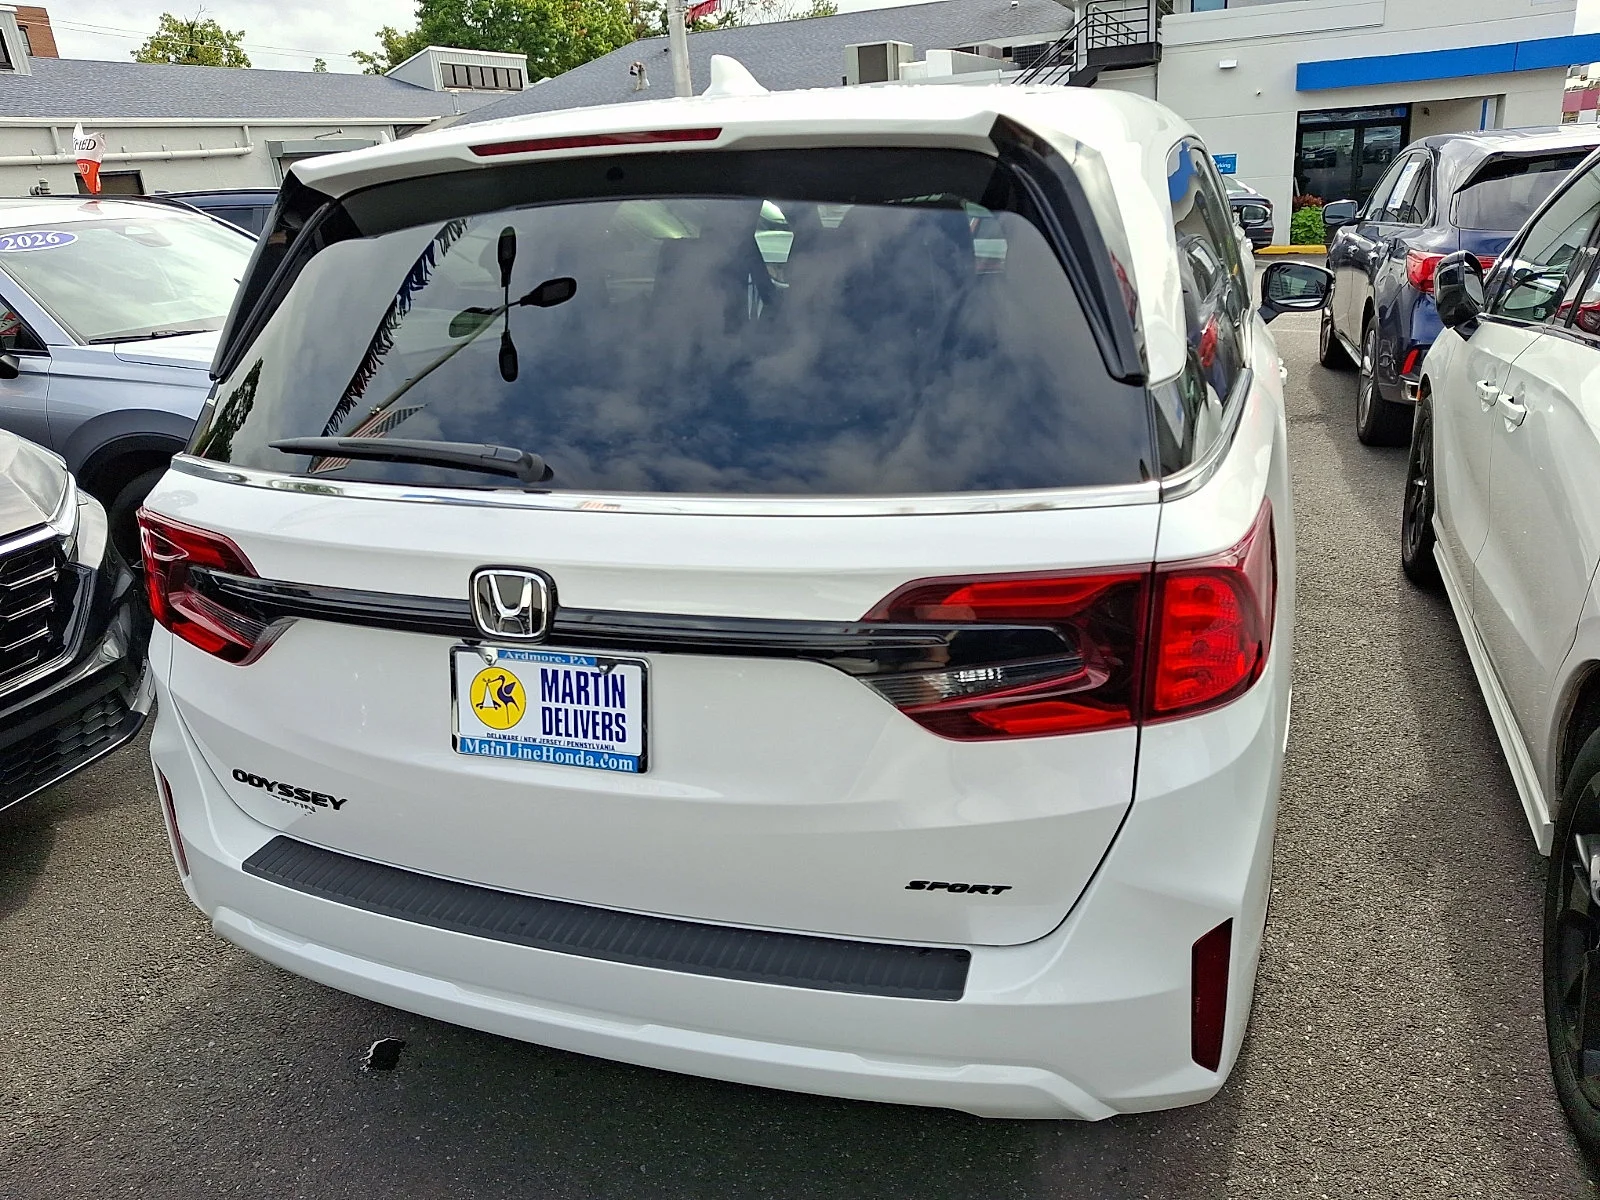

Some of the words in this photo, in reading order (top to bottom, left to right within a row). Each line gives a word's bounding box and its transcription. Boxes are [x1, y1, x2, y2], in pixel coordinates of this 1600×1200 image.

[1, 232, 60, 250] 2026
[569, 656, 588, 665] PA
[540, 668, 626, 709] MARTIN
[541, 706, 627, 743] DELIVERS
[464, 738, 634, 771] MainLineHonda.com
[486, 732, 519, 742] DELAWARE
[538, 738, 562, 747] JERSEY
[566, 741, 616, 752] PENNSYLVANIA
[232, 768, 348, 811] ODYSSEY
[904, 880, 1013, 896] SPORT
